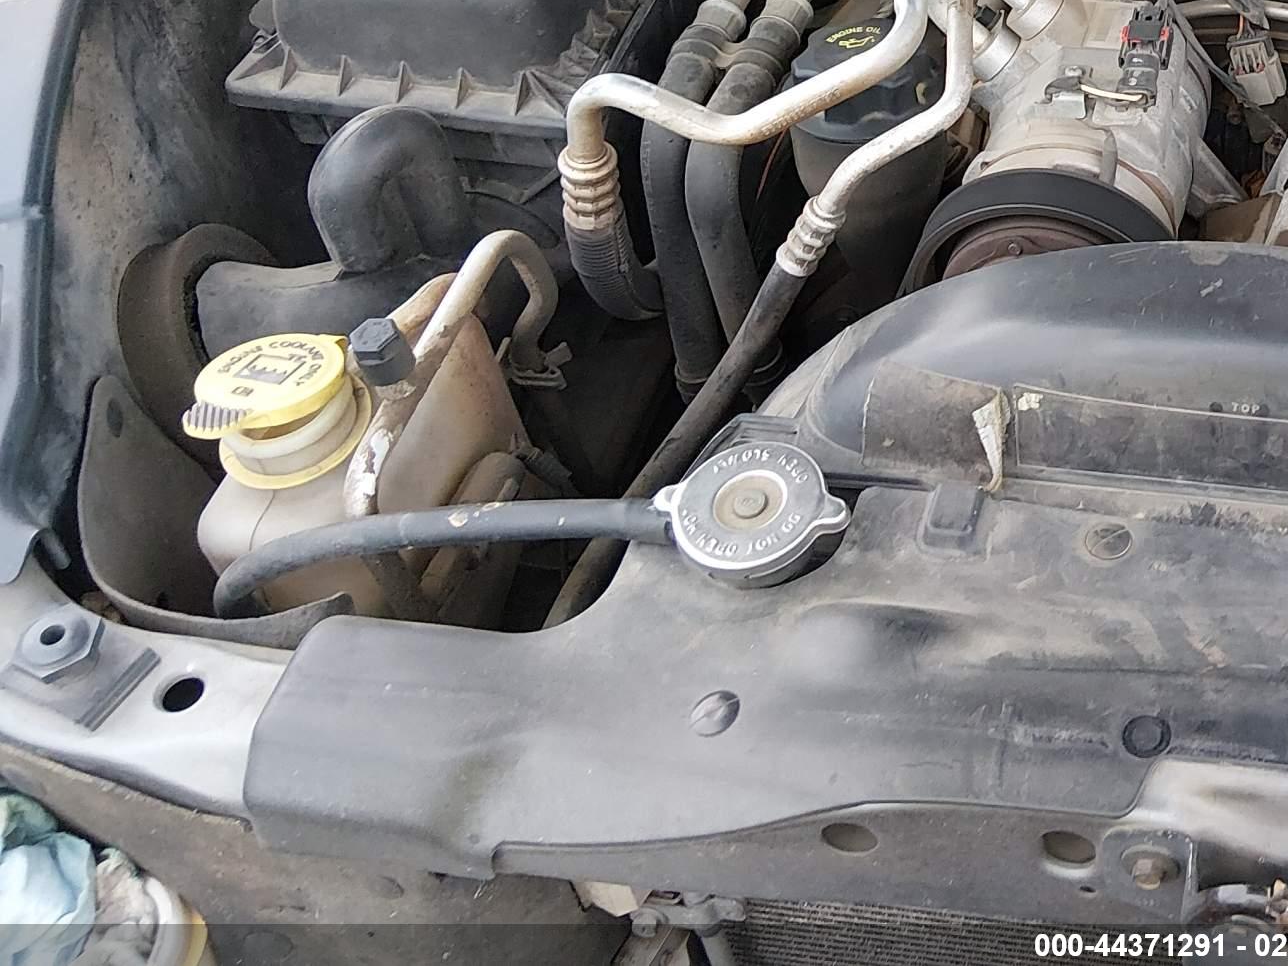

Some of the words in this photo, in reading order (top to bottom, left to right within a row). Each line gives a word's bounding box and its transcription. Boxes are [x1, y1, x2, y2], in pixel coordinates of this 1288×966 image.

[826, 26, 863, 43] ENGINE
[865, 26, 881, 34] OIL
[268, 340, 325, 361] COOLANT
[1231, 401, 1260, 414] TOP
